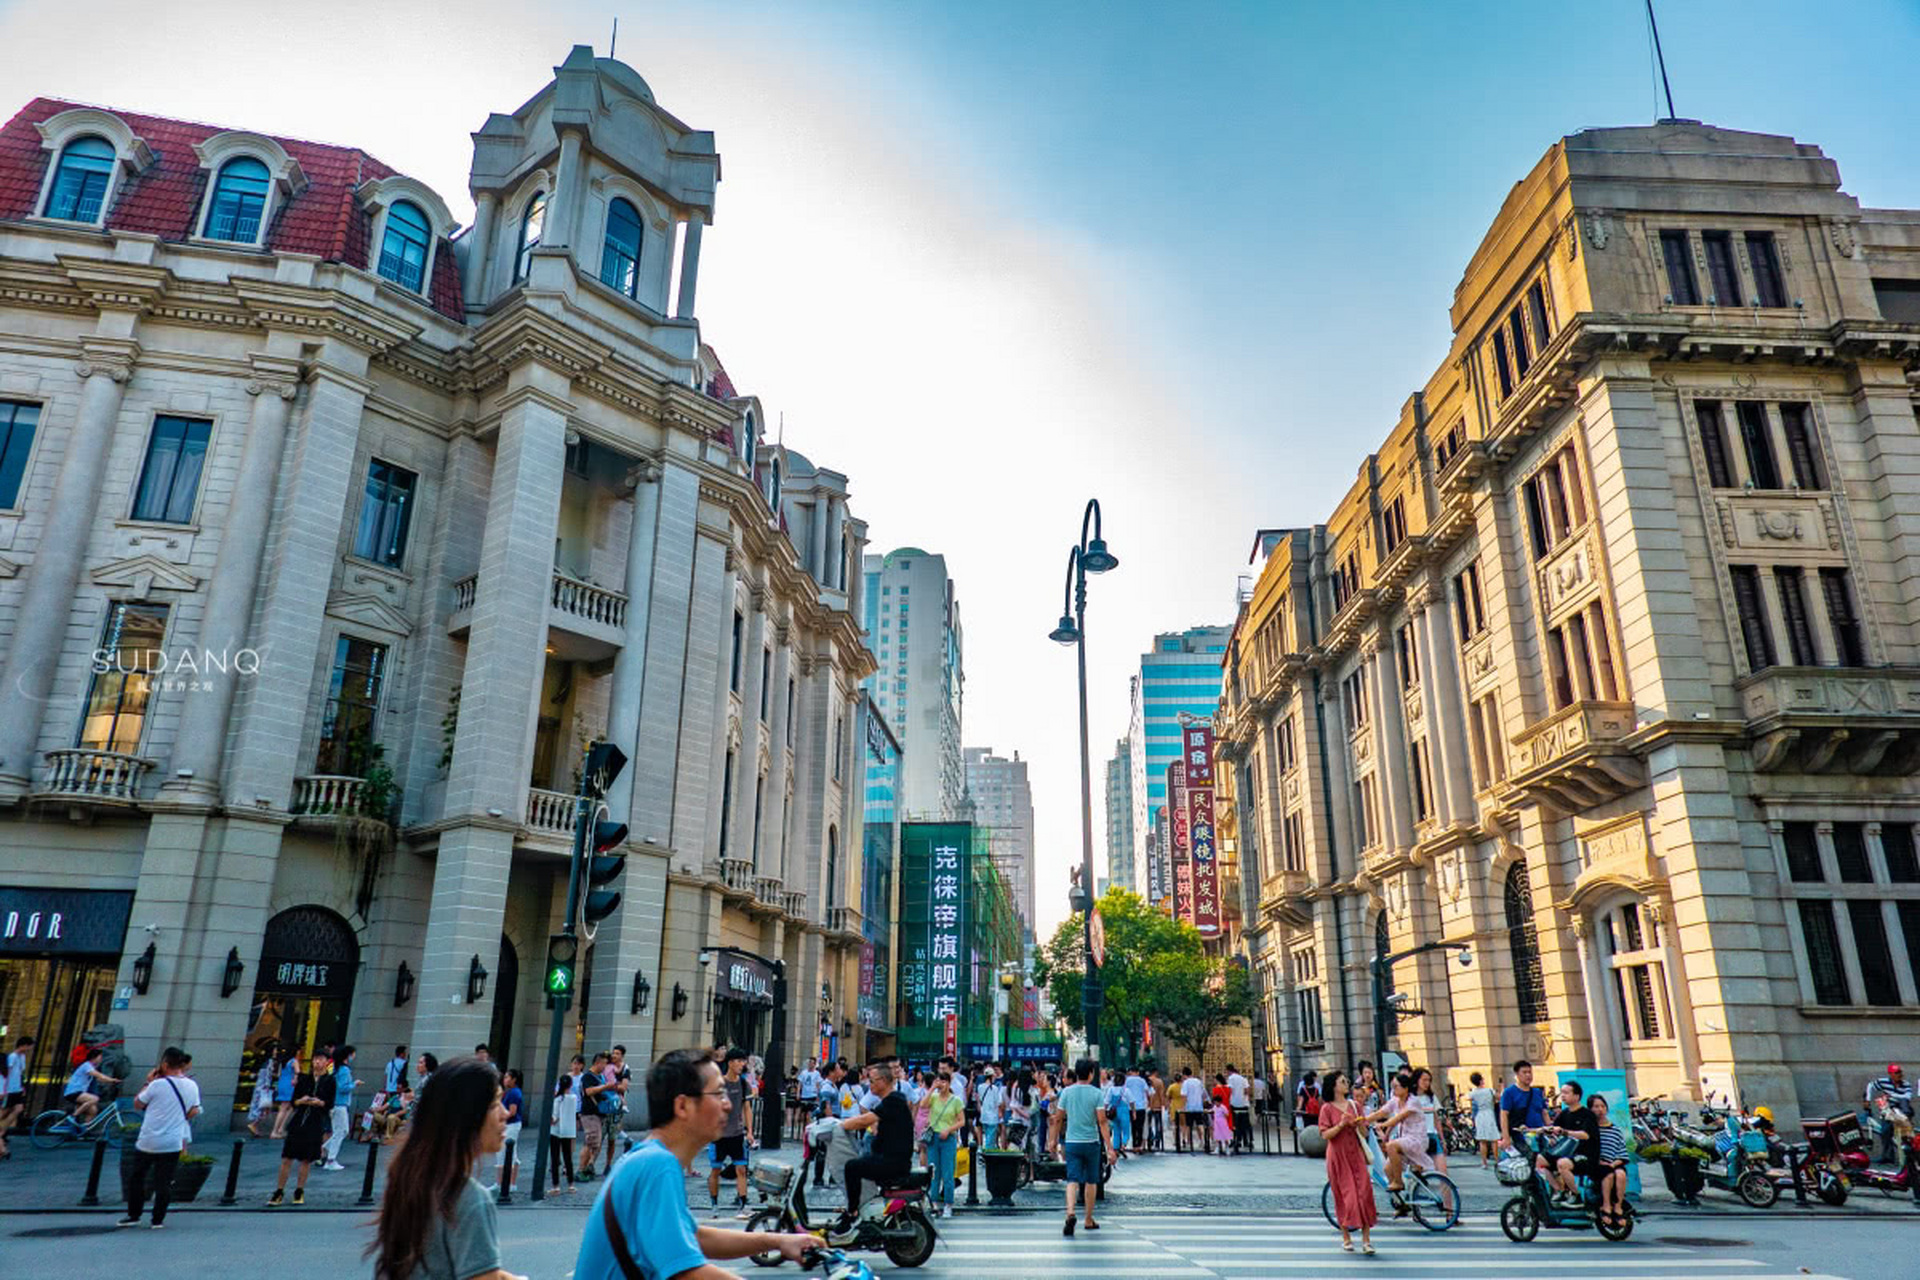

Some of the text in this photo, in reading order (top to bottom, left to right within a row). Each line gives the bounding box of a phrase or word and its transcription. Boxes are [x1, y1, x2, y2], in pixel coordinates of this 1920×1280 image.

[1193, 793, 1216, 917] 民众眼镜批发城
[277, 962, 330, 986] 明牌珠宝
[933, 846, 958, 1020] 克徕帝旗舰店
